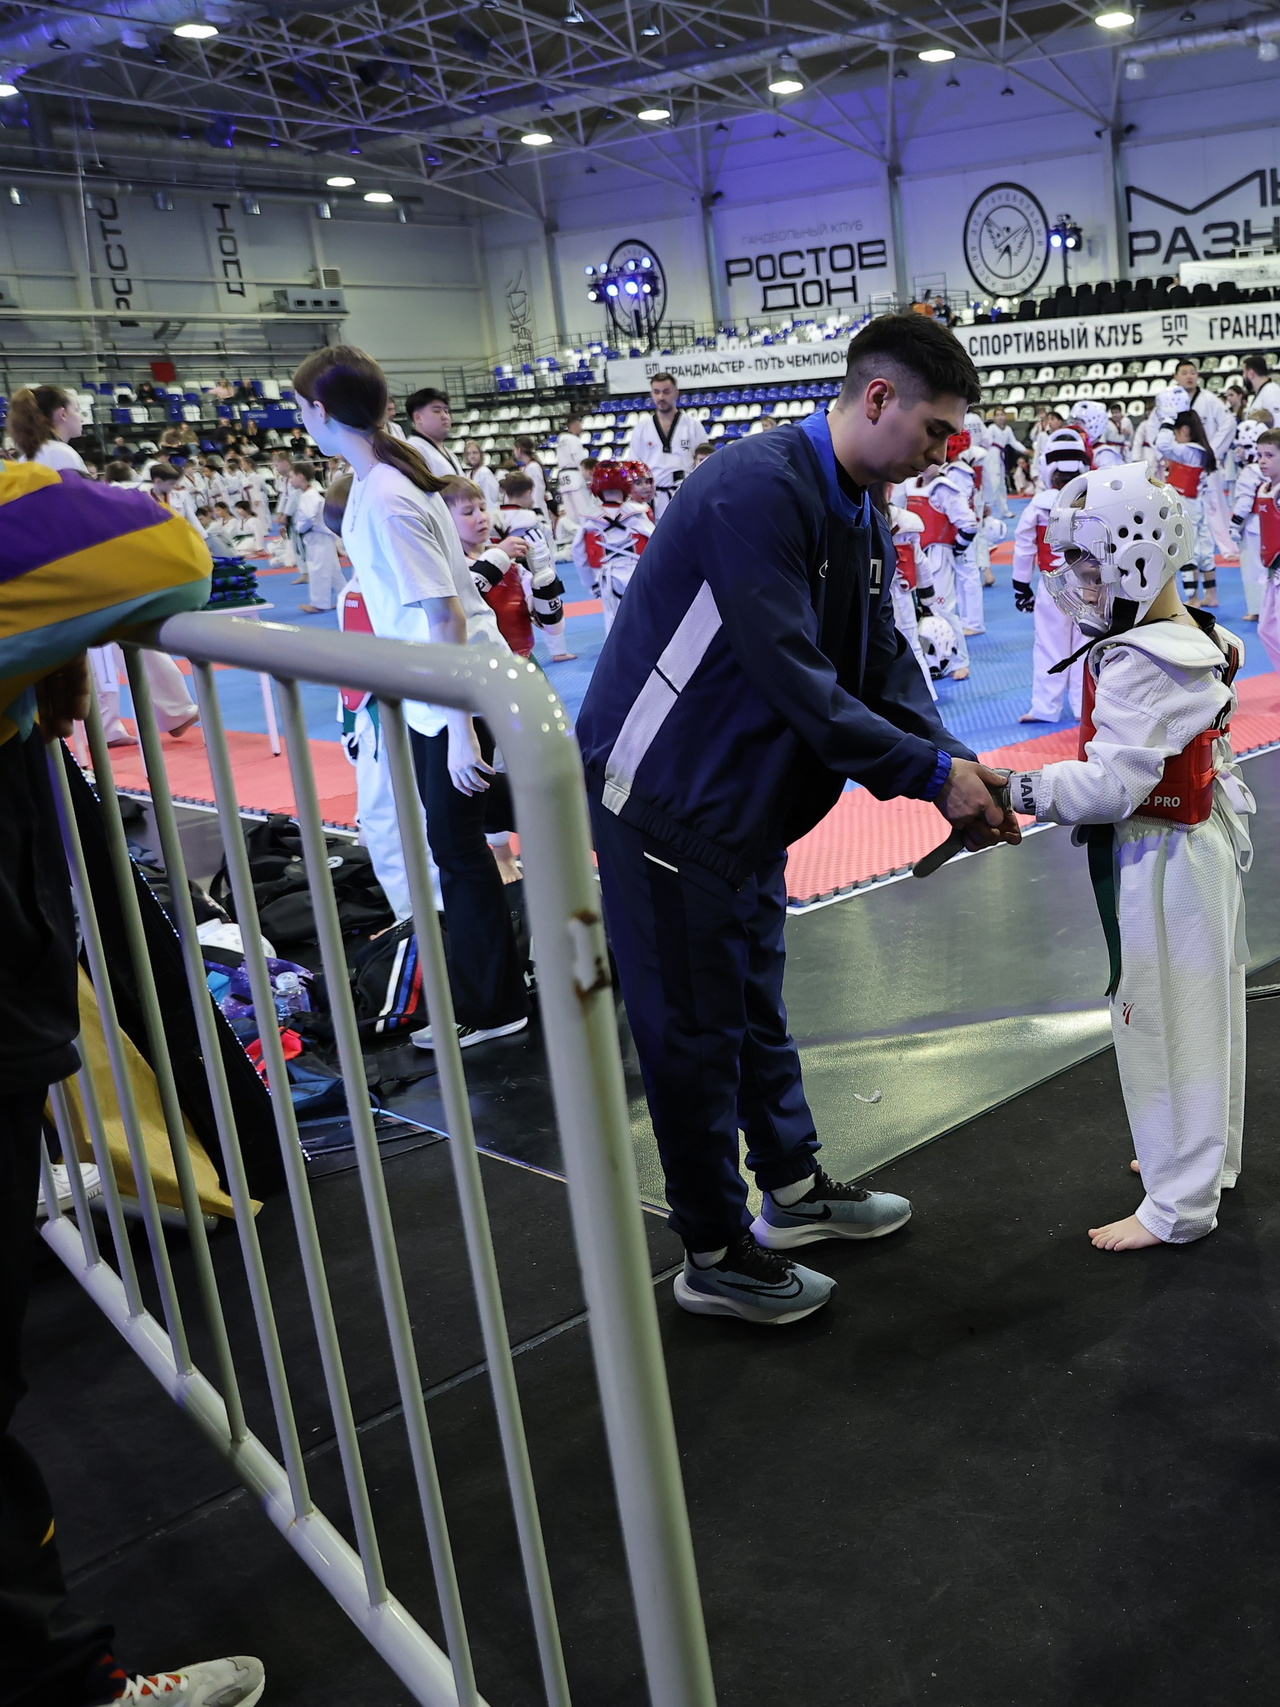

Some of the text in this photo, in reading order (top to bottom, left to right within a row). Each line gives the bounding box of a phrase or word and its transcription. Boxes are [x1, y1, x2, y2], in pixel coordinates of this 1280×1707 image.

[831, 220, 864, 234] КЛУБ
[761, 275, 859, 313] ДОН
[969, 322, 1144, 357] СПОРТИВНЫЙ КЛУБ
[665, 361, 745, 379] ГРАНДМАСТЕР
[755, 356, 785, 371] ПУТЬ
[1154, 796, 1181, 807] PRO
